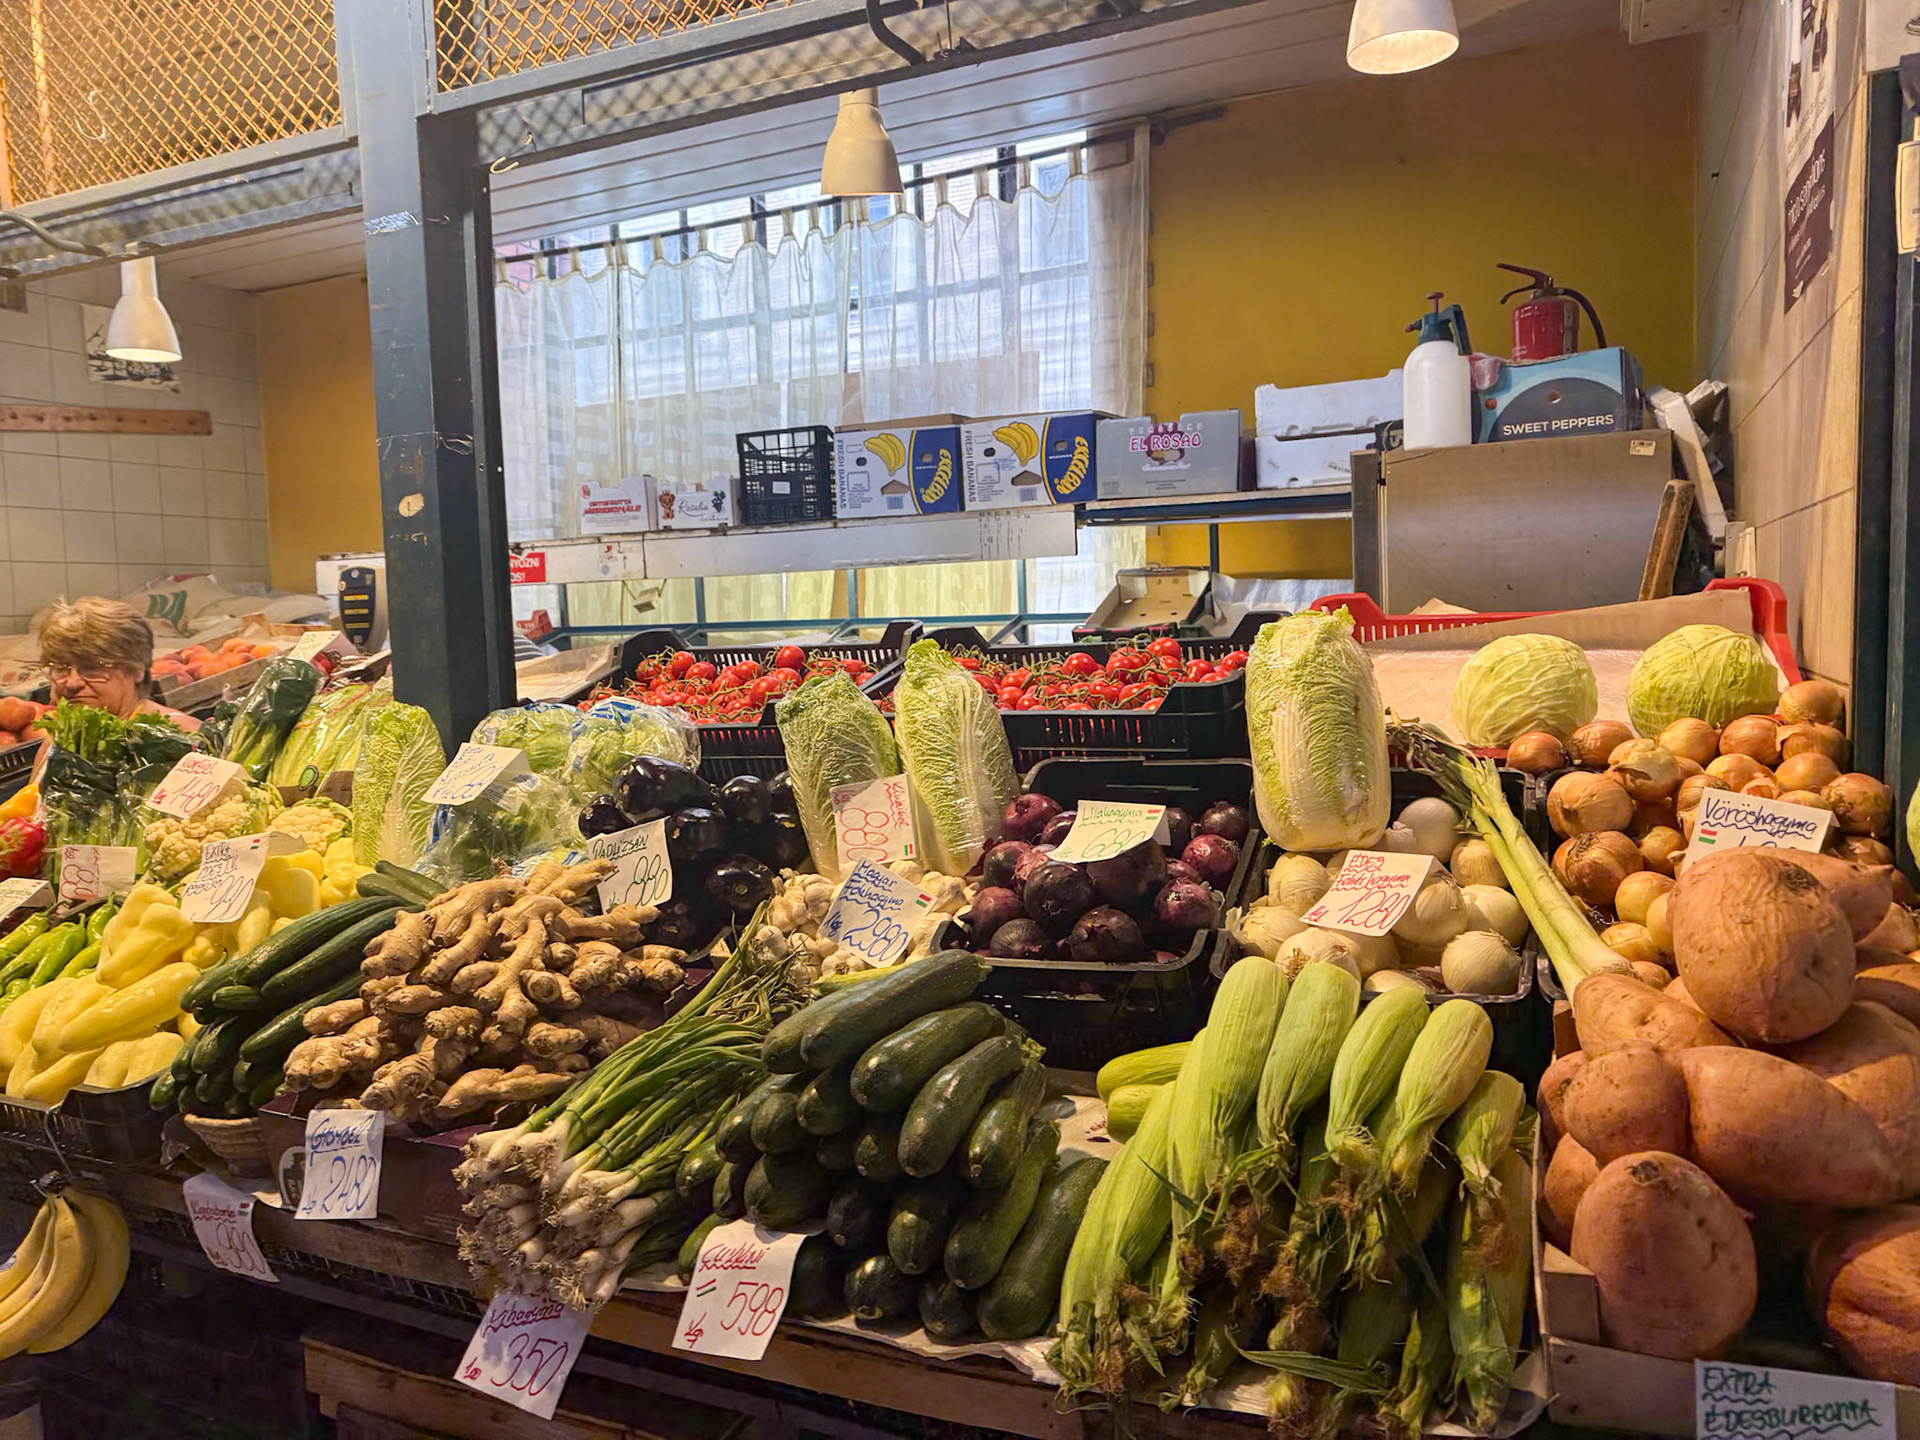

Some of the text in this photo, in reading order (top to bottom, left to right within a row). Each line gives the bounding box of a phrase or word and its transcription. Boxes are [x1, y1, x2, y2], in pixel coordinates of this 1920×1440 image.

[1129, 436, 1148, 451] EL
[1503, 414, 1614, 436] SWEET PEPPERS
[837, 440, 847, 509] FRESH BANANAS
[964, 430, 976, 503] FRESH BANANAS
[1706, 797, 1818, 838] Vöröshagyma
[858, 860, 897, 887] Magyar
[720, 1281, 785, 1336] 598
[490, 1333, 568, 1396] 350
[1704, 1366, 1776, 1394] EXTRA
